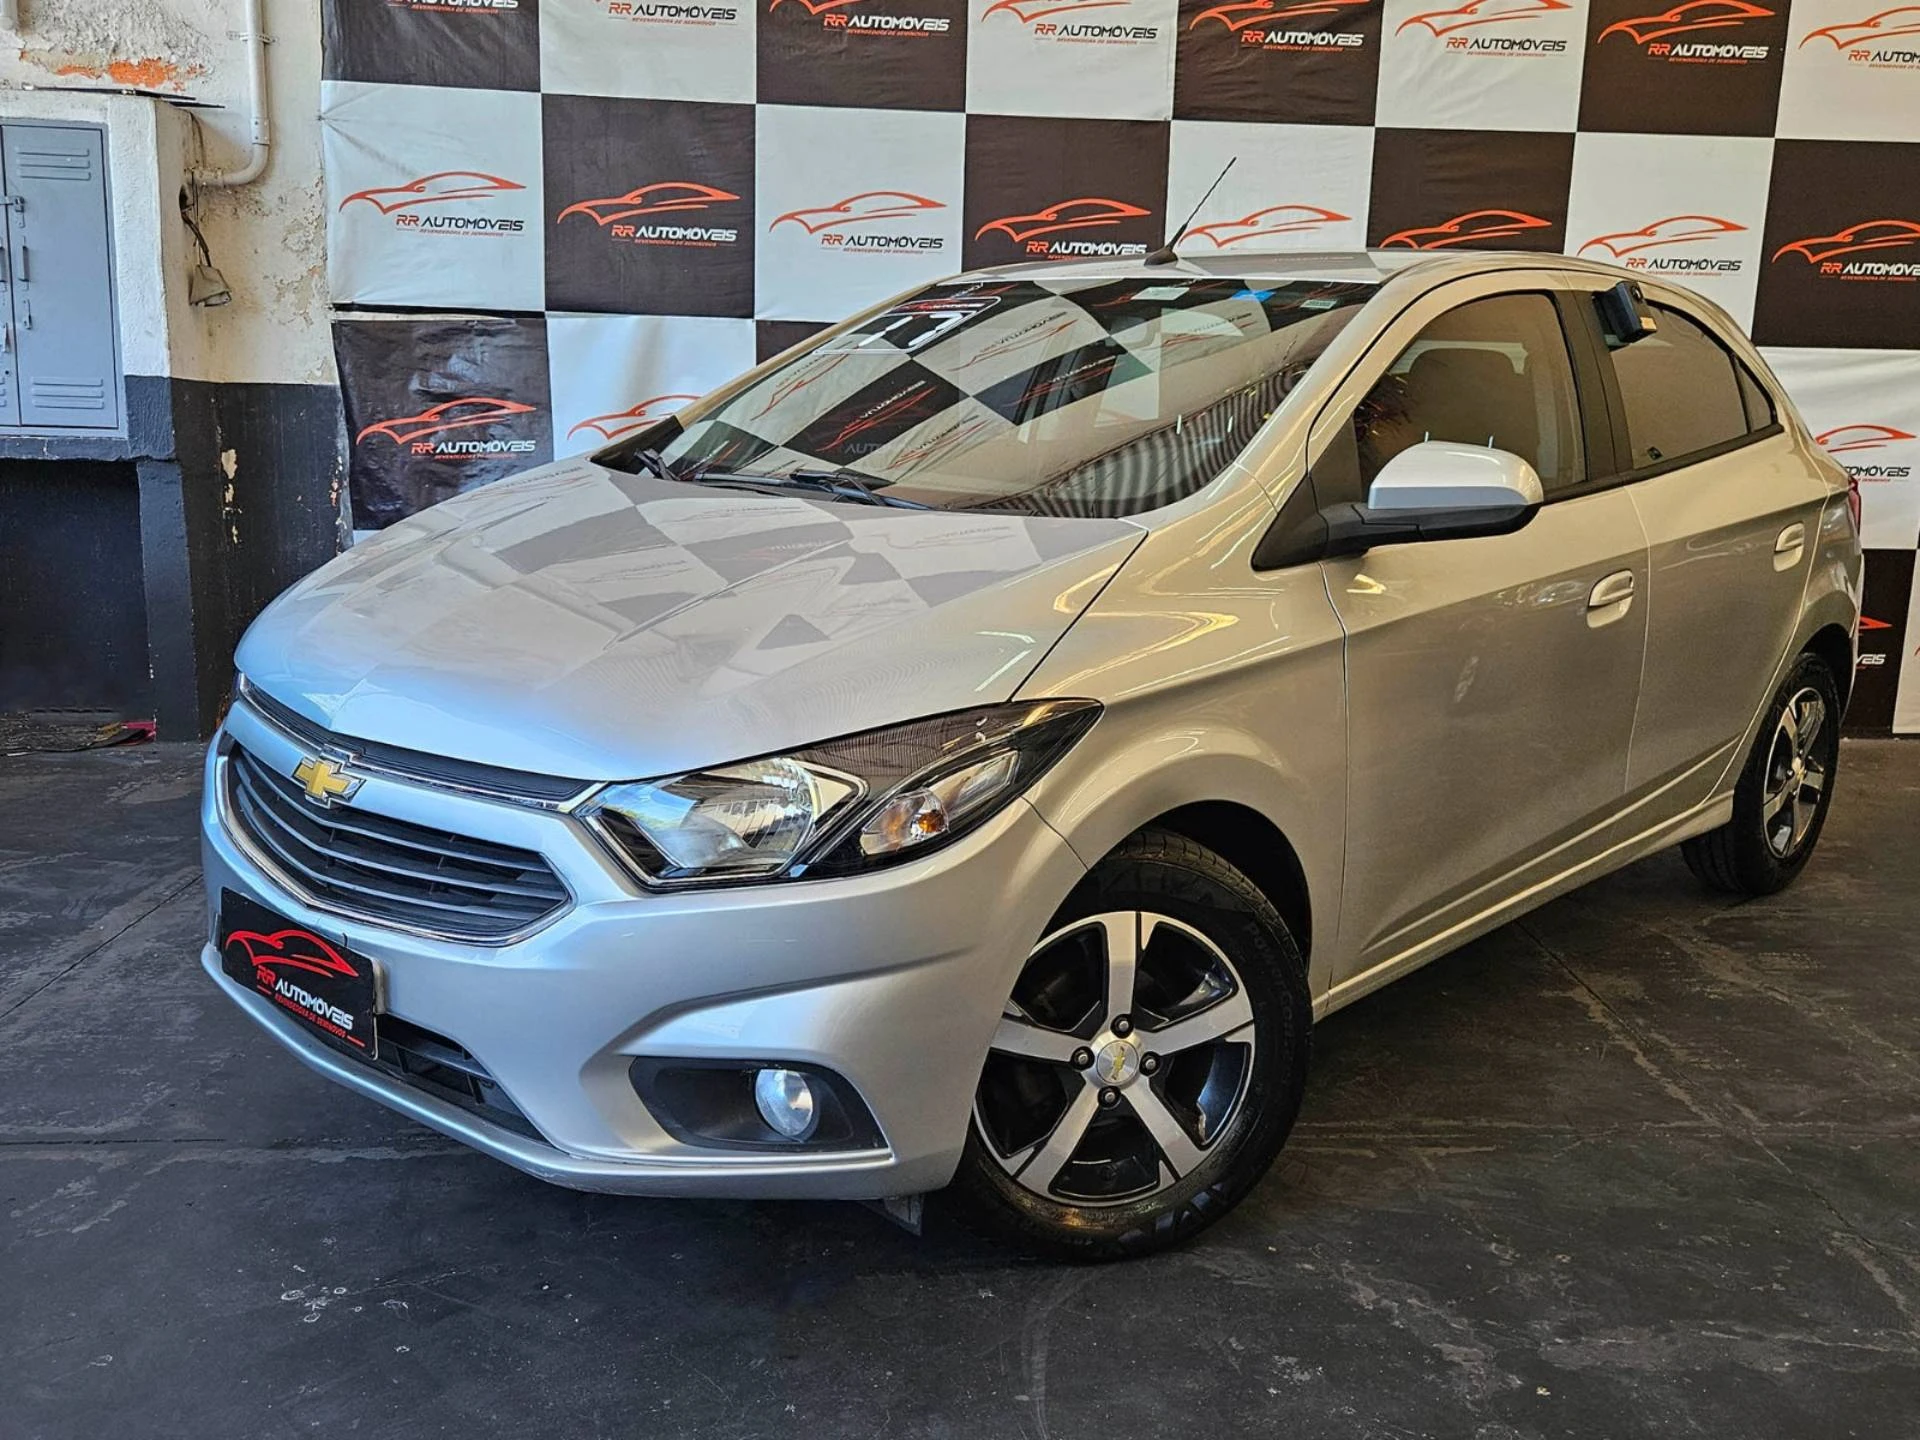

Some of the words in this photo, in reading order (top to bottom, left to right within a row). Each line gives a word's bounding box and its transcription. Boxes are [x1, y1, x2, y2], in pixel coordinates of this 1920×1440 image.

[608, 3, 632, 15] RR
[824, 14, 847, 27] RR
[1034, 23, 1057, 35] RR
[1241, 30, 1265, 43] RR
[1446, 37, 1468, 48] RR
[1648, 43, 1671, 56] RR
[1848, 49, 1870, 61] RR
[396, 214, 420, 227] RR
[611, 225, 635, 237] RR
[821, 234, 844, 246] RR
[1026, 241, 1049, 253] RR
[1626, 257, 1647, 268] RR
[1820, 262, 1843, 273] RR
[411, 442, 434, 454] RR
[257, 964, 276, 988] RR
